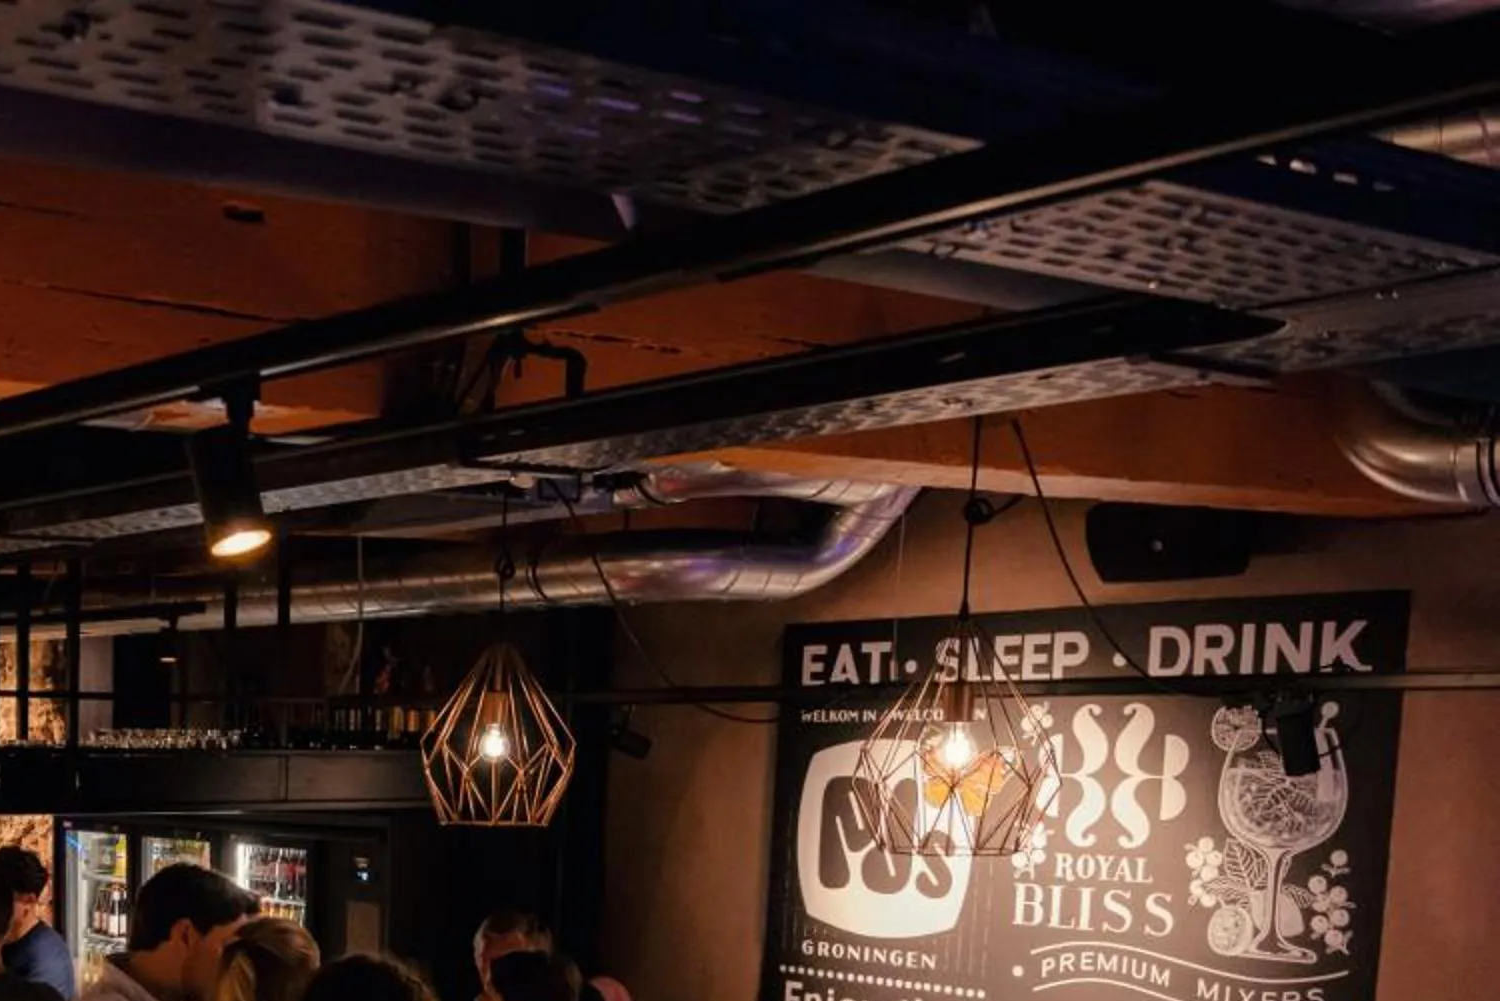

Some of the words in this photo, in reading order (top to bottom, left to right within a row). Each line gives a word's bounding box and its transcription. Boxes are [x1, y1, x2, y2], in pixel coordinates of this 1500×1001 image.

[801, 640, 892, 686] EAT
[933, 630, 1090, 683] SLEEP
[1147, 619, 1373, 677] DRINK
[801, 708, 859, 723] WELKOM
[863, 709, 877, 723] IN
[891, 707, 944, 722] WELCO
[1054, 852, 1153, 884] ROYAL
[1012, 881, 1174, 937] BLISS
[801, 939, 938, 970] GRONINGEN
[1041, 950, 1171, 988] PREMIUM
